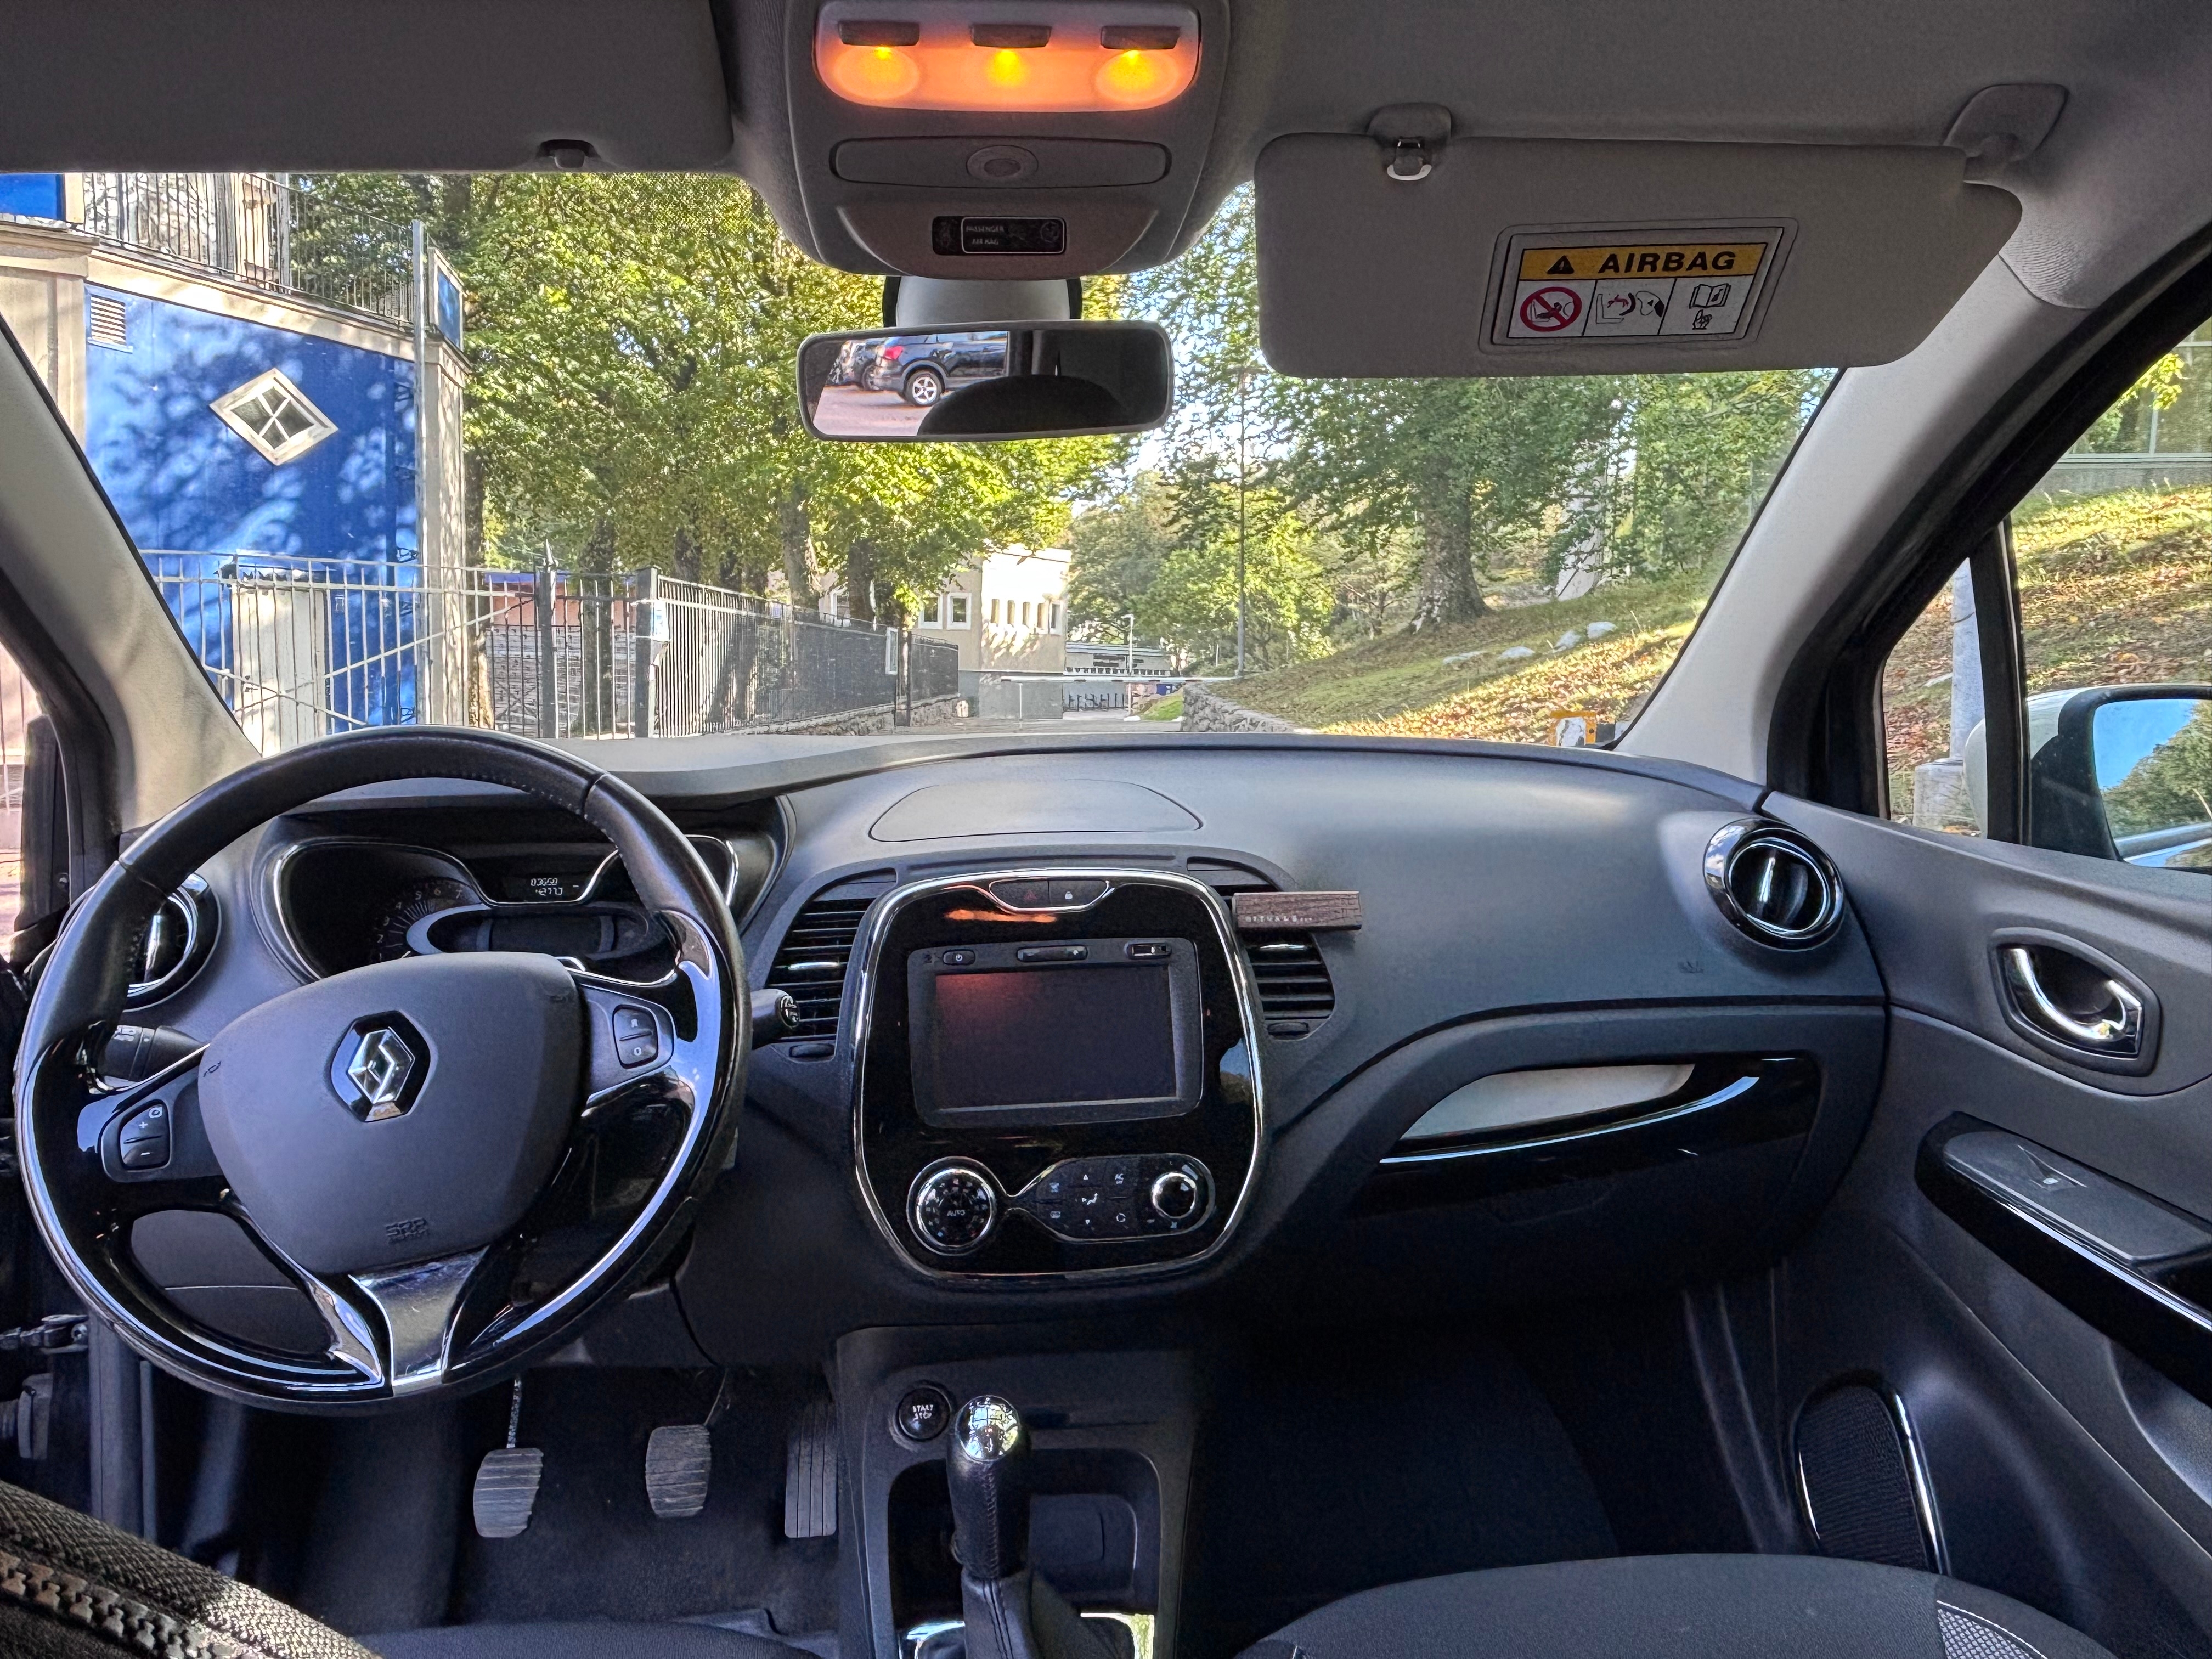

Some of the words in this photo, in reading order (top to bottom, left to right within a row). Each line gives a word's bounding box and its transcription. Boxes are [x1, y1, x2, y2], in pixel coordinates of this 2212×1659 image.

[1597, 250, 1736, 274] AIRBAG
[912, 1404, 934, 1413] START
[913, 1412, 933, 1421] STOP
